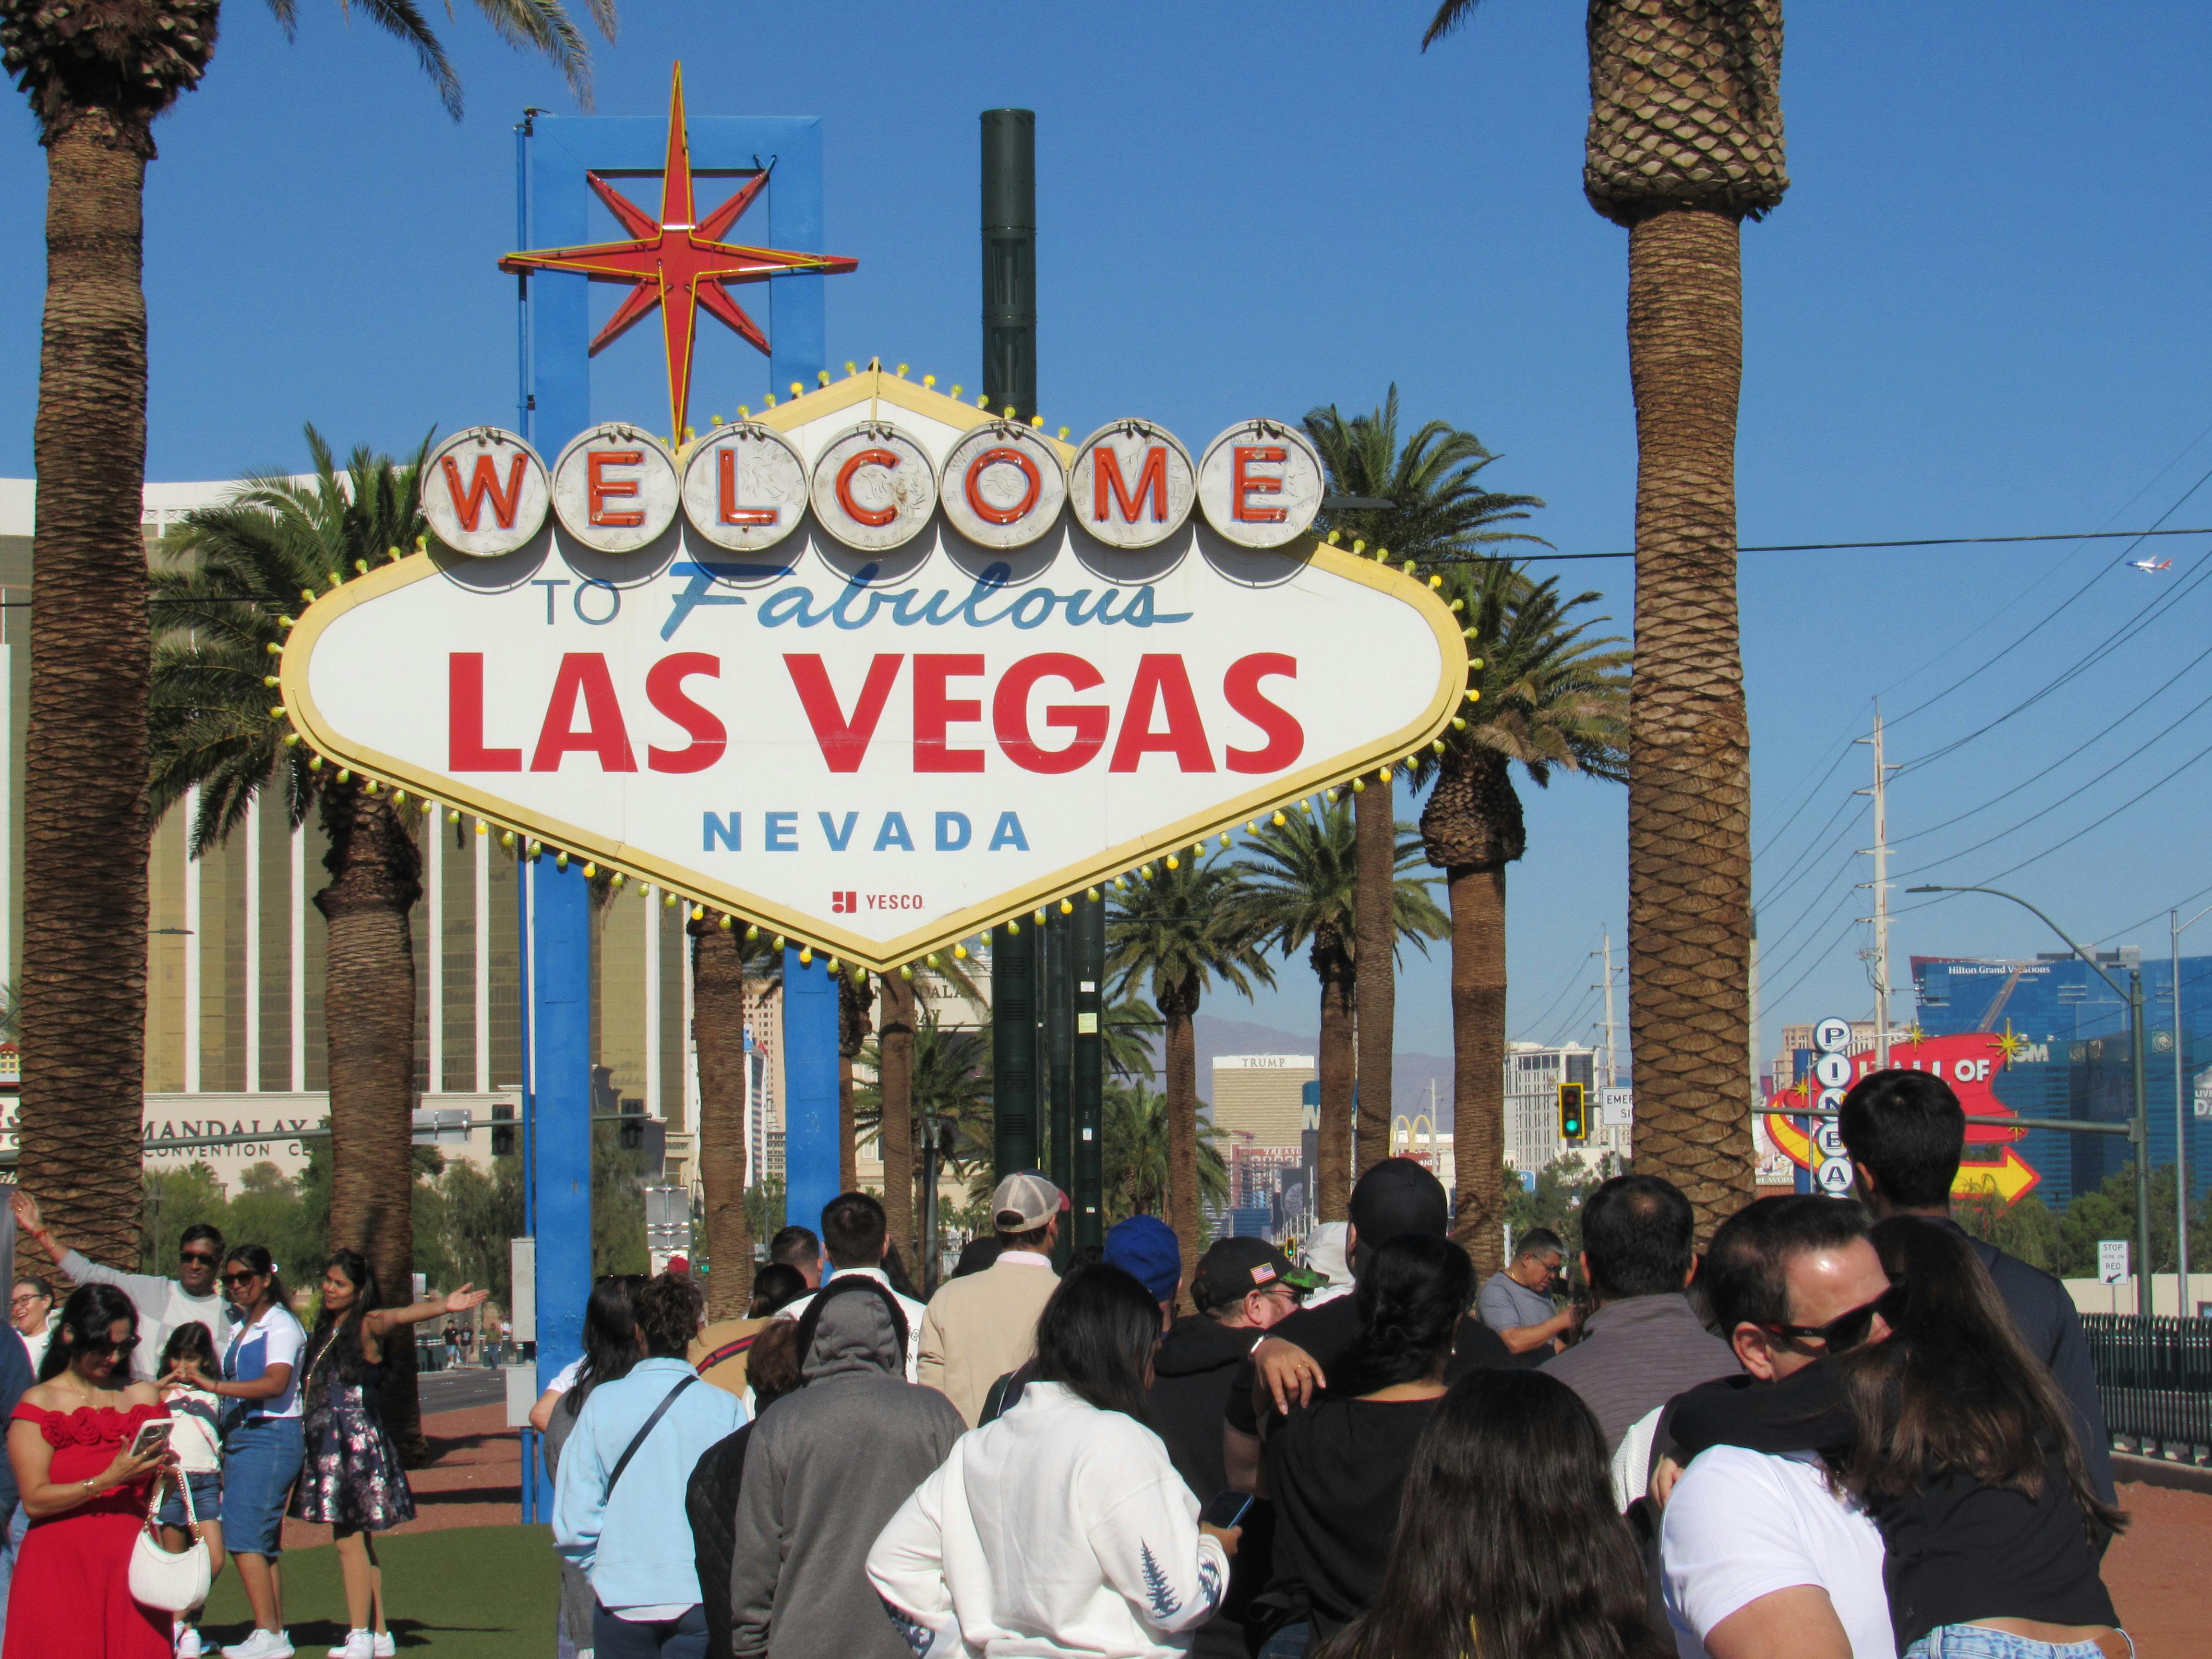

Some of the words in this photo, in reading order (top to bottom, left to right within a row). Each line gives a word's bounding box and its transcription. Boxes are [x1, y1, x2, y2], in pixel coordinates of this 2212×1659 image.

[440, 446, 1290, 532] WELCOME
[531, 578, 621, 625] TO
[661, 561, 1193, 642] Fabulous
[449, 651, 727, 774] LAS
[782, 651, 1305, 774] VEGAS
[703, 811, 1030, 852] NEVADA
[866, 894, 923, 910] YESCO
[1948, 966, 1977, 974] Hilton
[1979, 965, 2006, 974] Grand
[2007, 965, 2051, 973] Vcations
[2011, 1044, 2050, 1062] GM
[1241, 1058, 1285, 1068] TRUMP
[1954, 1059, 1990, 1082] OF
[1607, 1095, 1633, 1104] EMER
[1621, 1109, 1631, 1118] SI
[144, 1143, 270, 1157] CONVENTION
